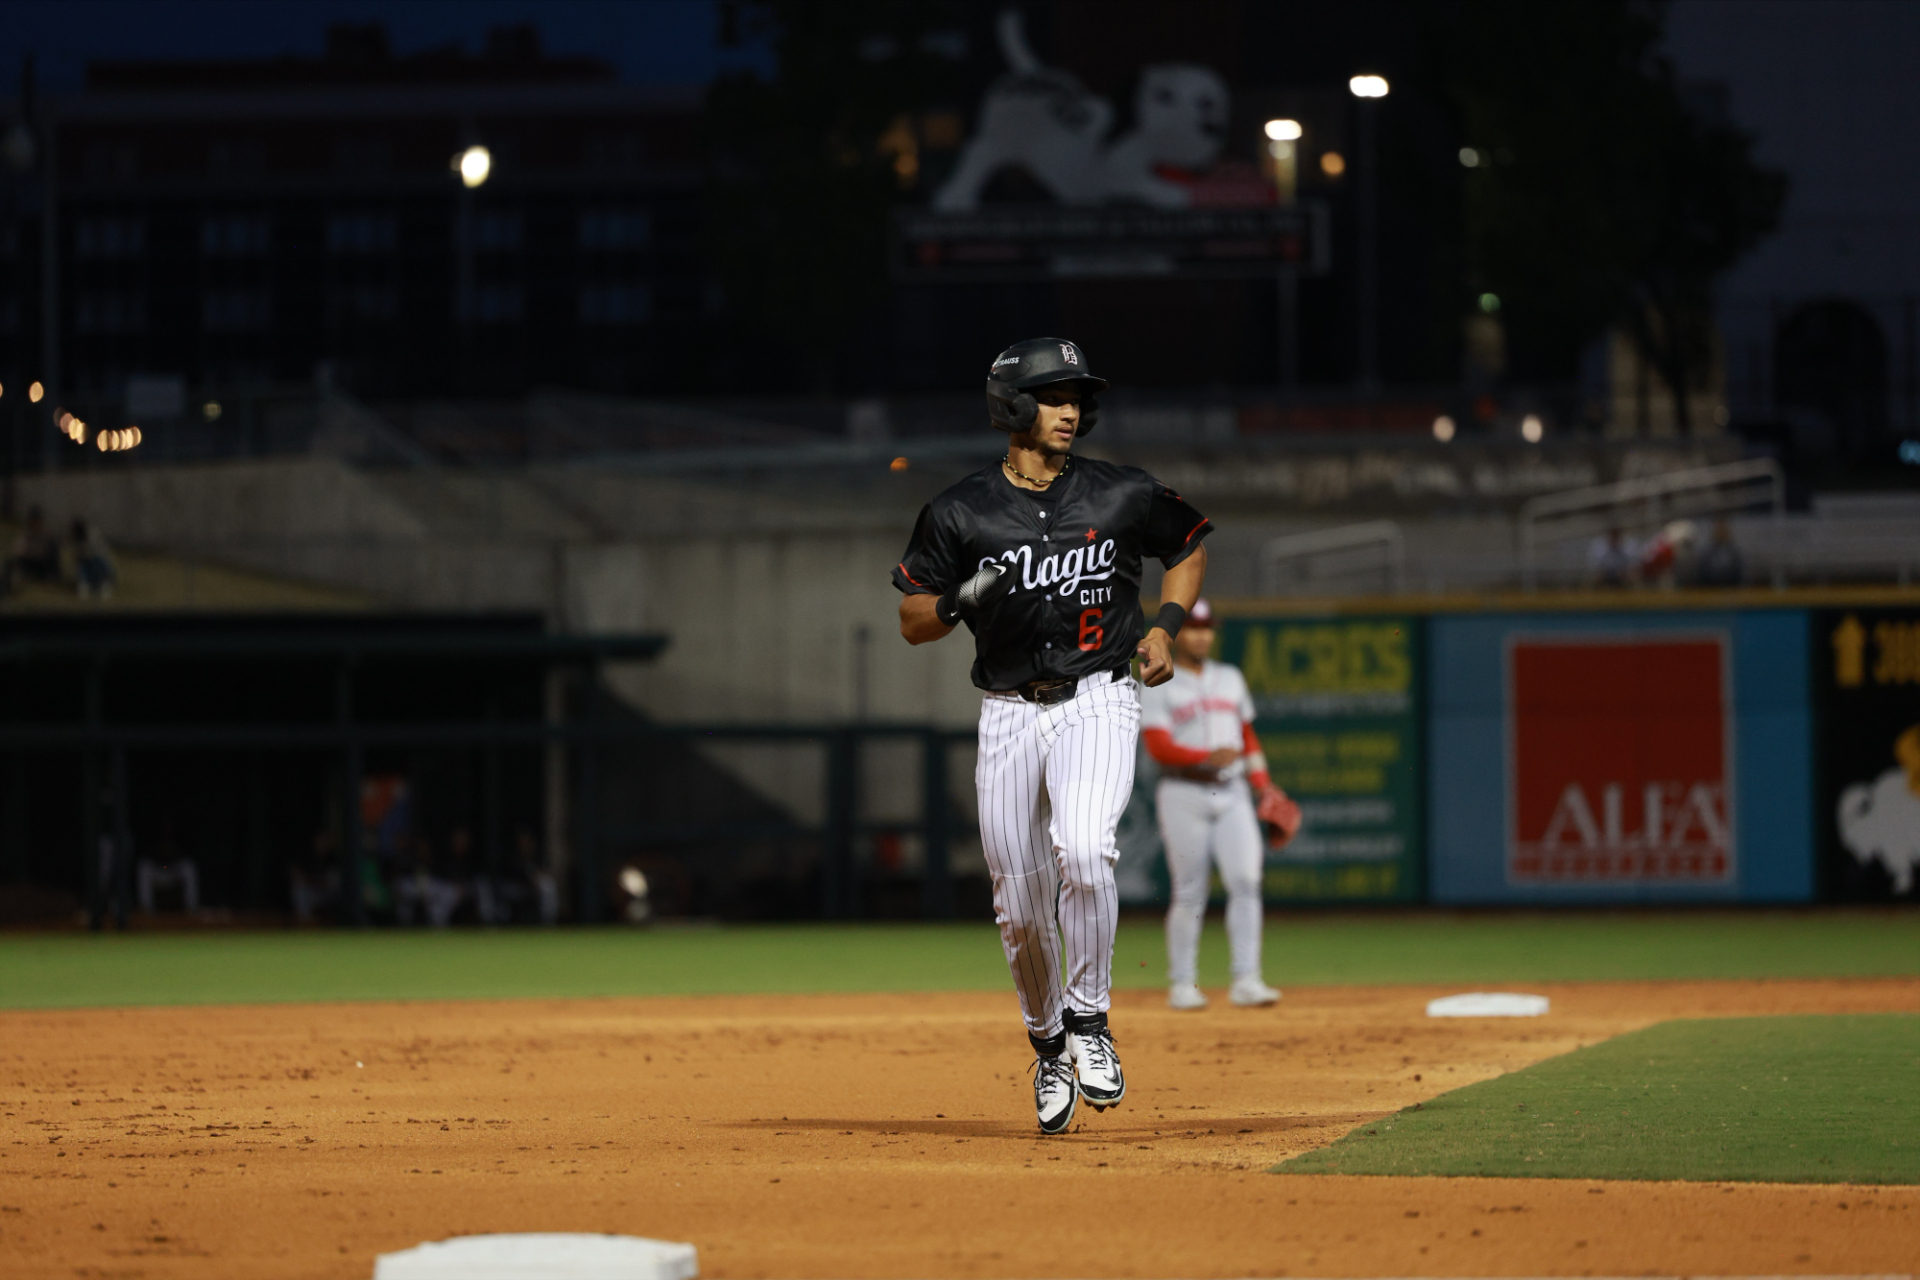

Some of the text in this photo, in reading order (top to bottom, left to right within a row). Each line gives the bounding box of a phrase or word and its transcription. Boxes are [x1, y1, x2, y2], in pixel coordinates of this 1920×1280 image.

[978, 538, 1117, 597] Magic
[1080, 586, 1112, 606] CITY
[1078, 608, 1104, 652] 6
[1240, 622, 1412, 691] ACRES
[1542, 782, 1730, 850] ALFA
